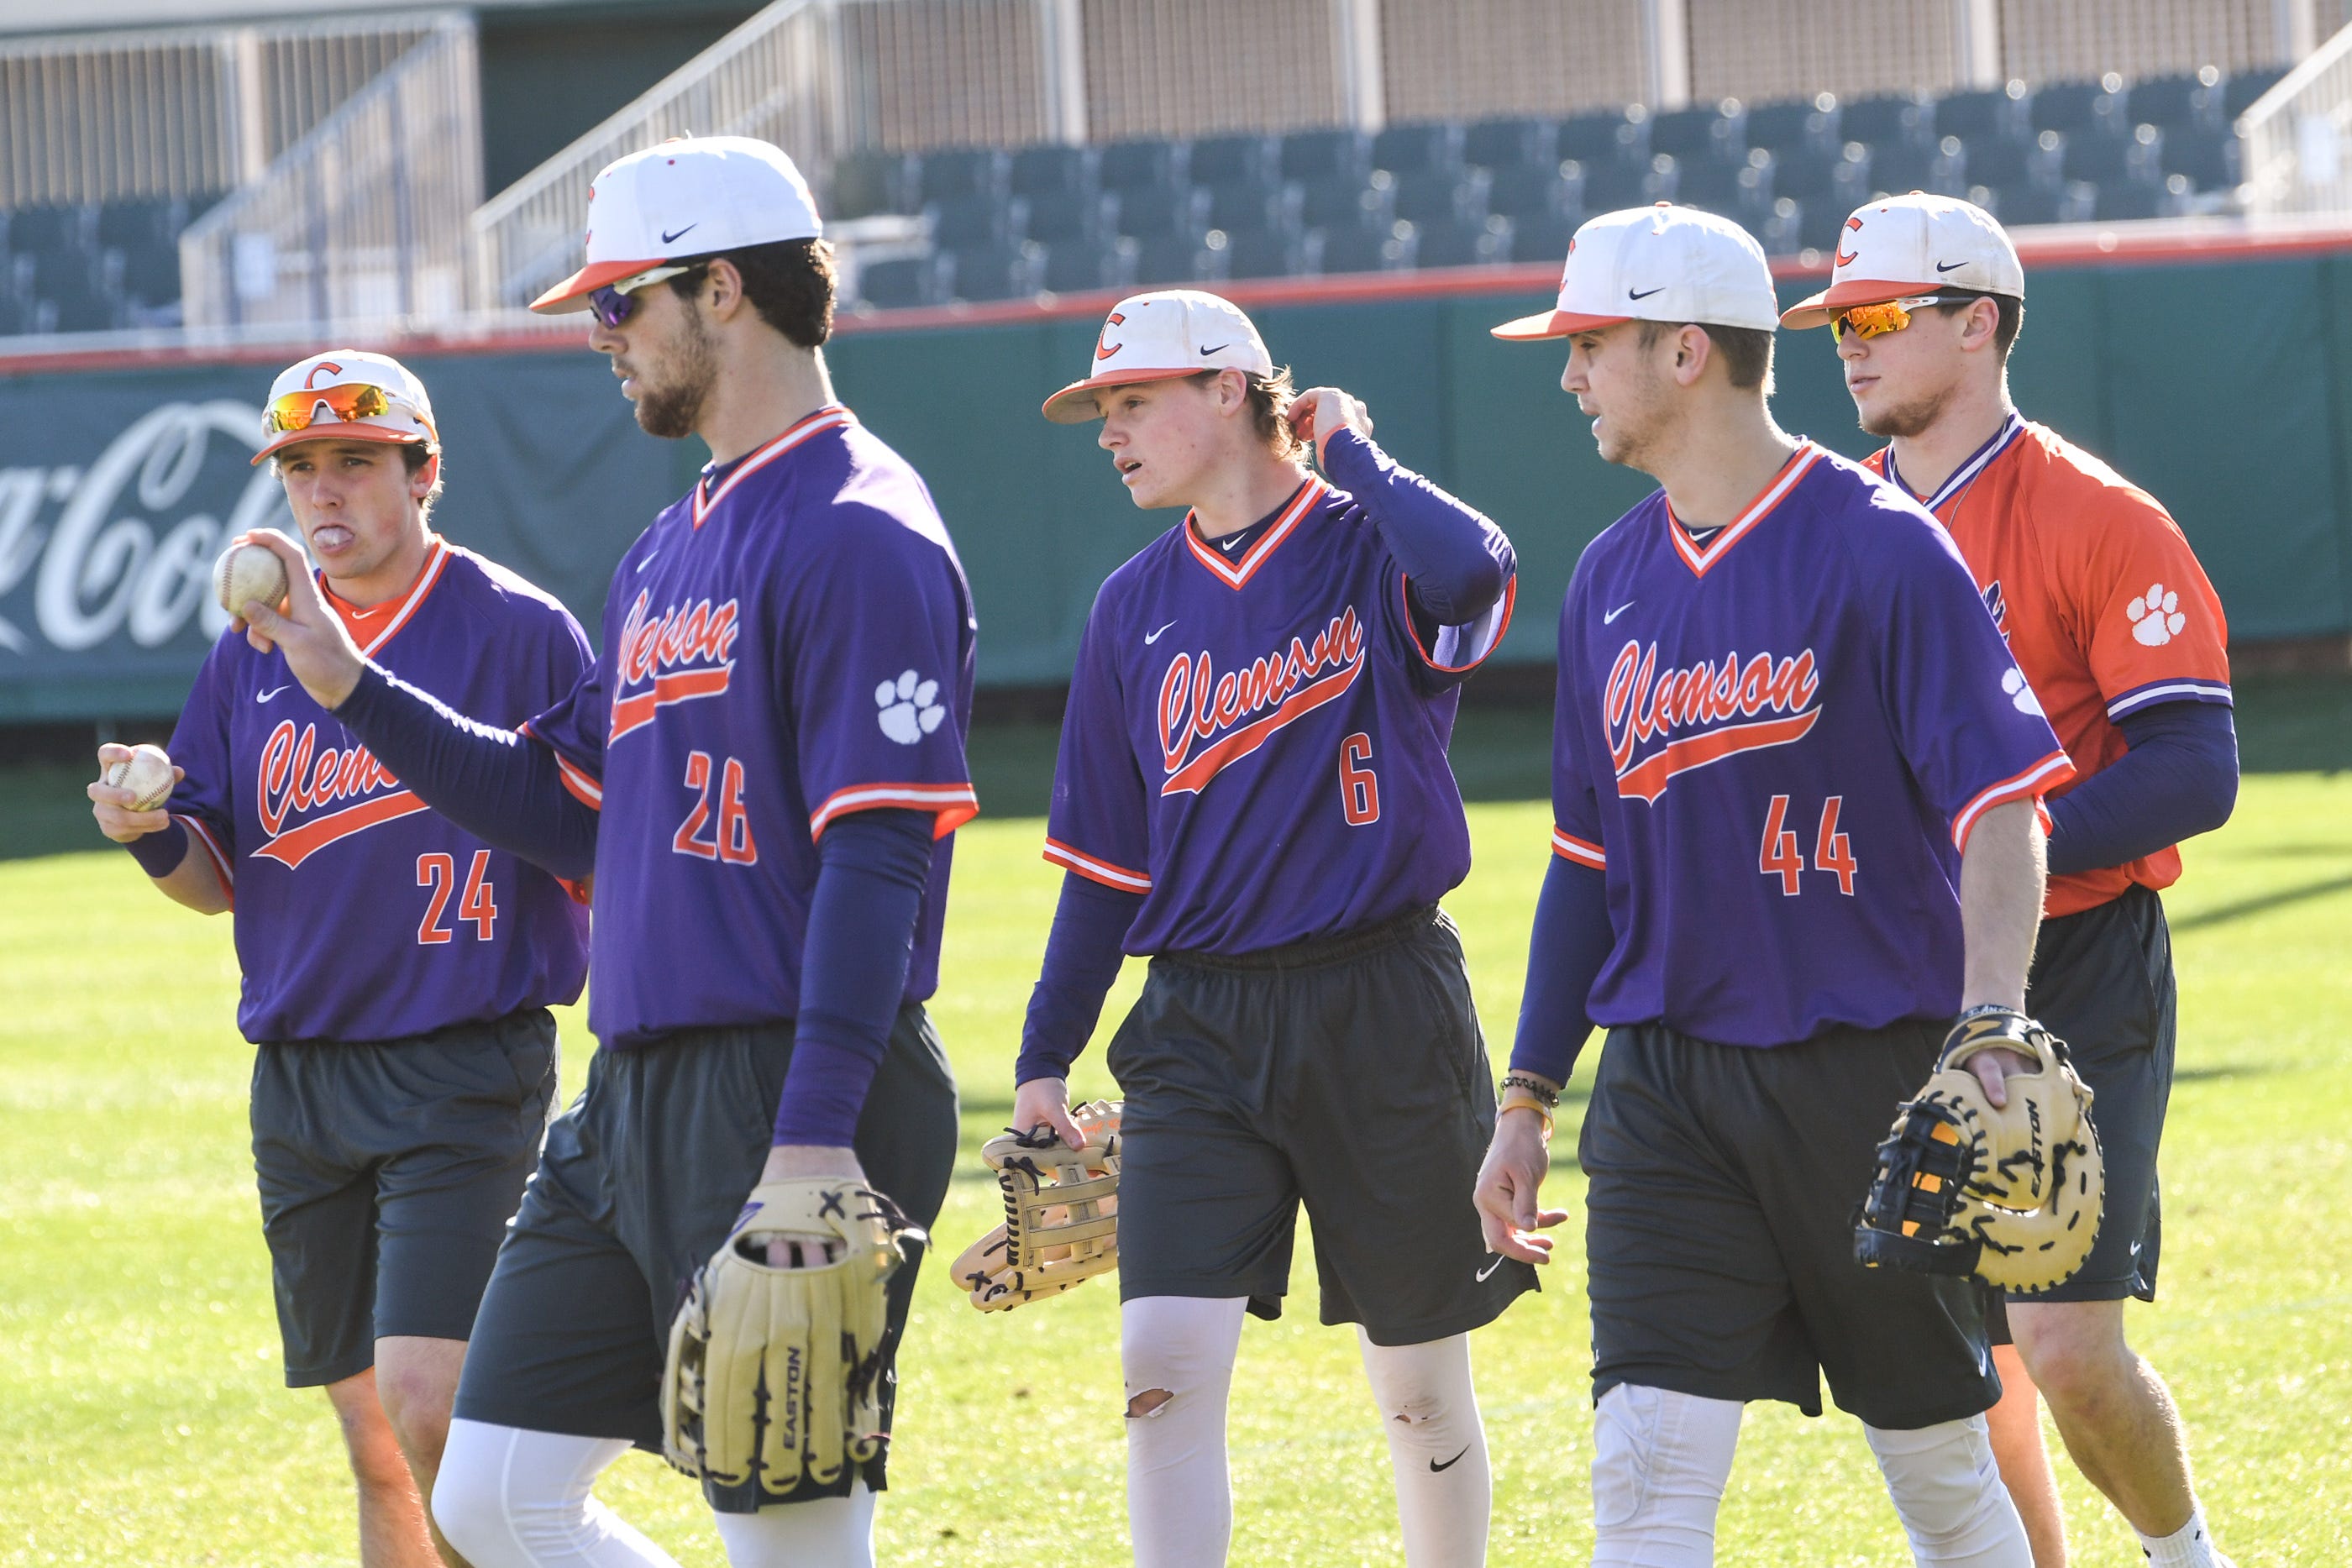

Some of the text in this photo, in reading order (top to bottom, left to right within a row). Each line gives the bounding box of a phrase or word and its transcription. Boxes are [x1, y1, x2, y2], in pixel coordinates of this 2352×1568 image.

[1096, 312, 1126, 360] C
[1158, 605, 1364, 774] Clemson
[1604, 639, 1819, 777] Clemson
[258, 719, 400, 838] Clem
[673, 750, 758, 867] 26
[1338, 732, 1380, 826] 6
[417, 848, 497, 945] 24
[1760, 794, 1857, 896] 44
[783, 1346, 801, 1450] EASTON
